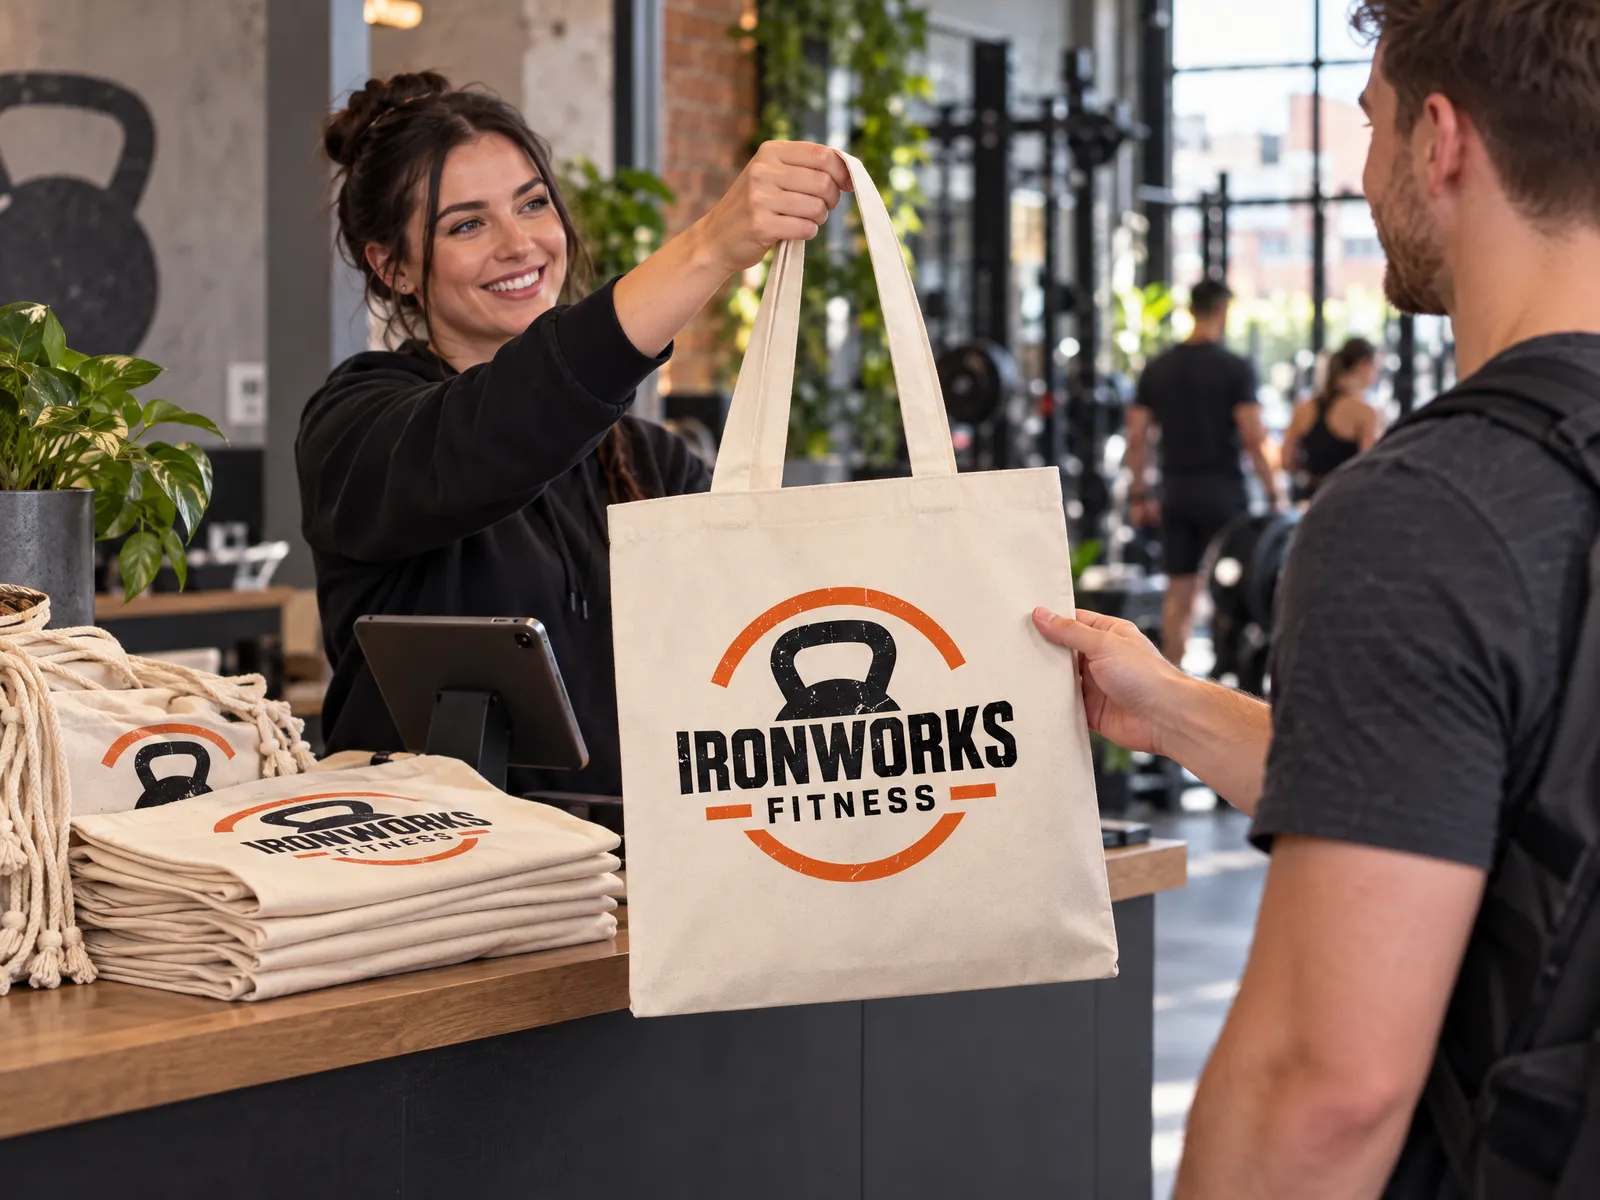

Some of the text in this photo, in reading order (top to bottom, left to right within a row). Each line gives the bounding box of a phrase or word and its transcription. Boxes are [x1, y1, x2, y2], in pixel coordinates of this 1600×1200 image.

[676, 700, 1018, 795] IRONWORKS
[767, 784, 936, 824] FITNESS
[240, 811, 493, 855] IRONWORKS
[335, 832, 454, 856] FITNESS
